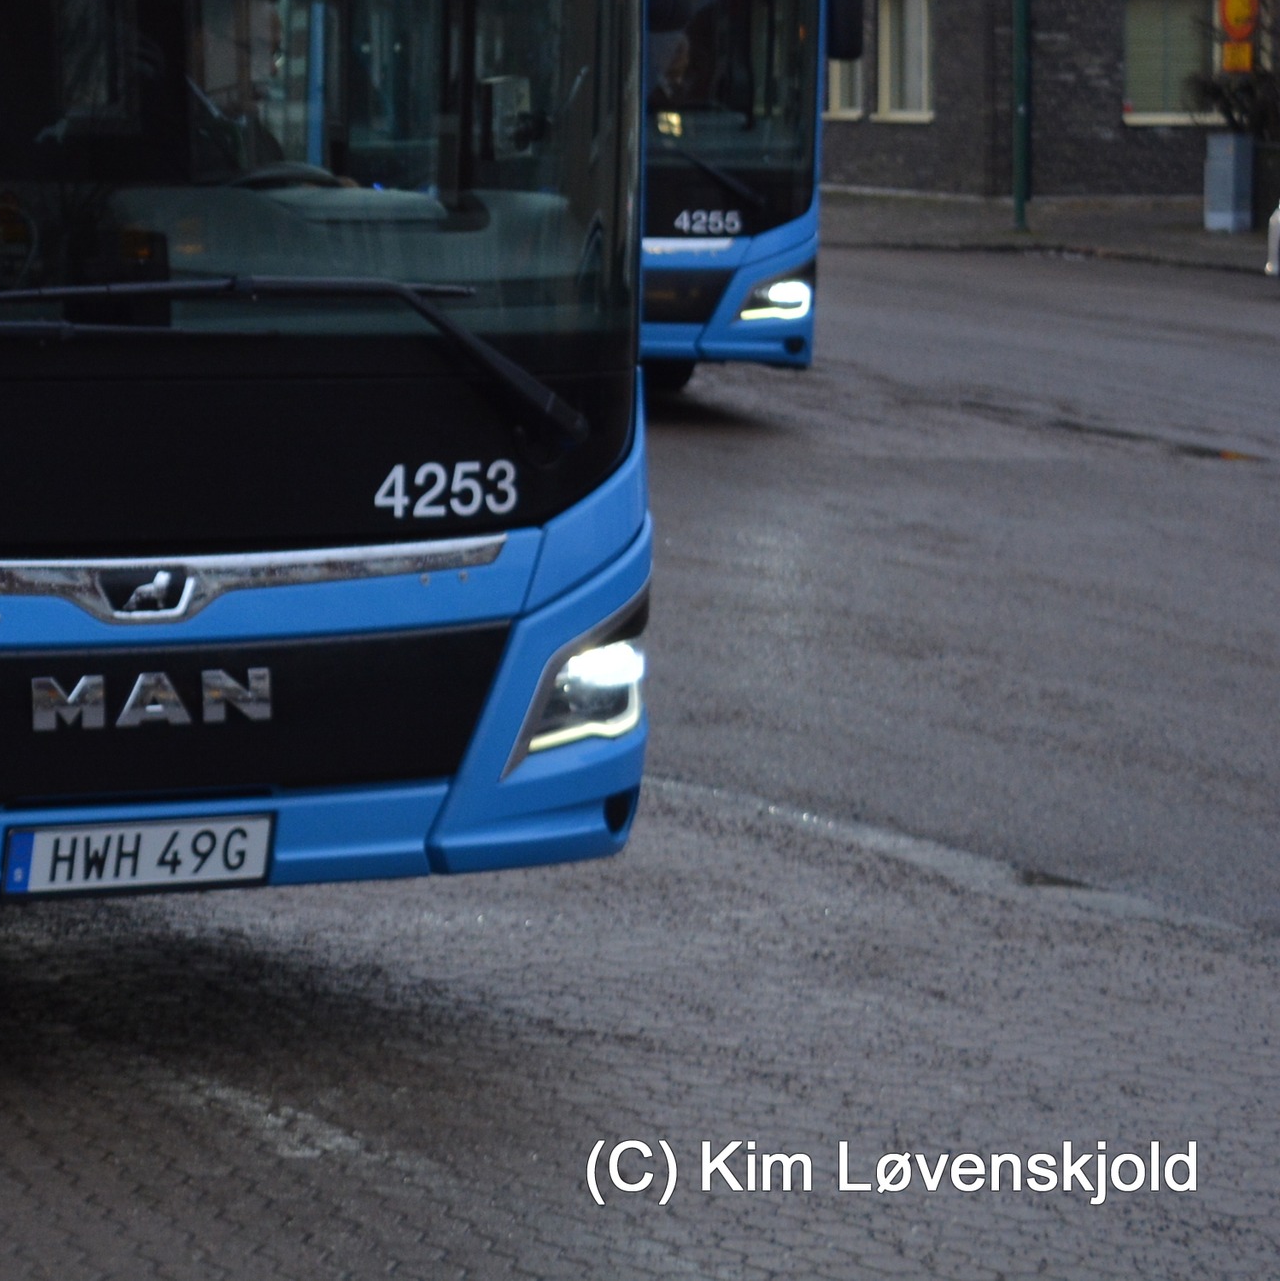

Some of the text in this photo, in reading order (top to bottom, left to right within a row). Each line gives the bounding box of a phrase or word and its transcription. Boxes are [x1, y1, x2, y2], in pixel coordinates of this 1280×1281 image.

[673, 209, 742, 236] 4255
[373, 458, 517, 519] 4253
[30, 667, 272, 731] MAN
[49, 826, 248, 883] HWH 49G
